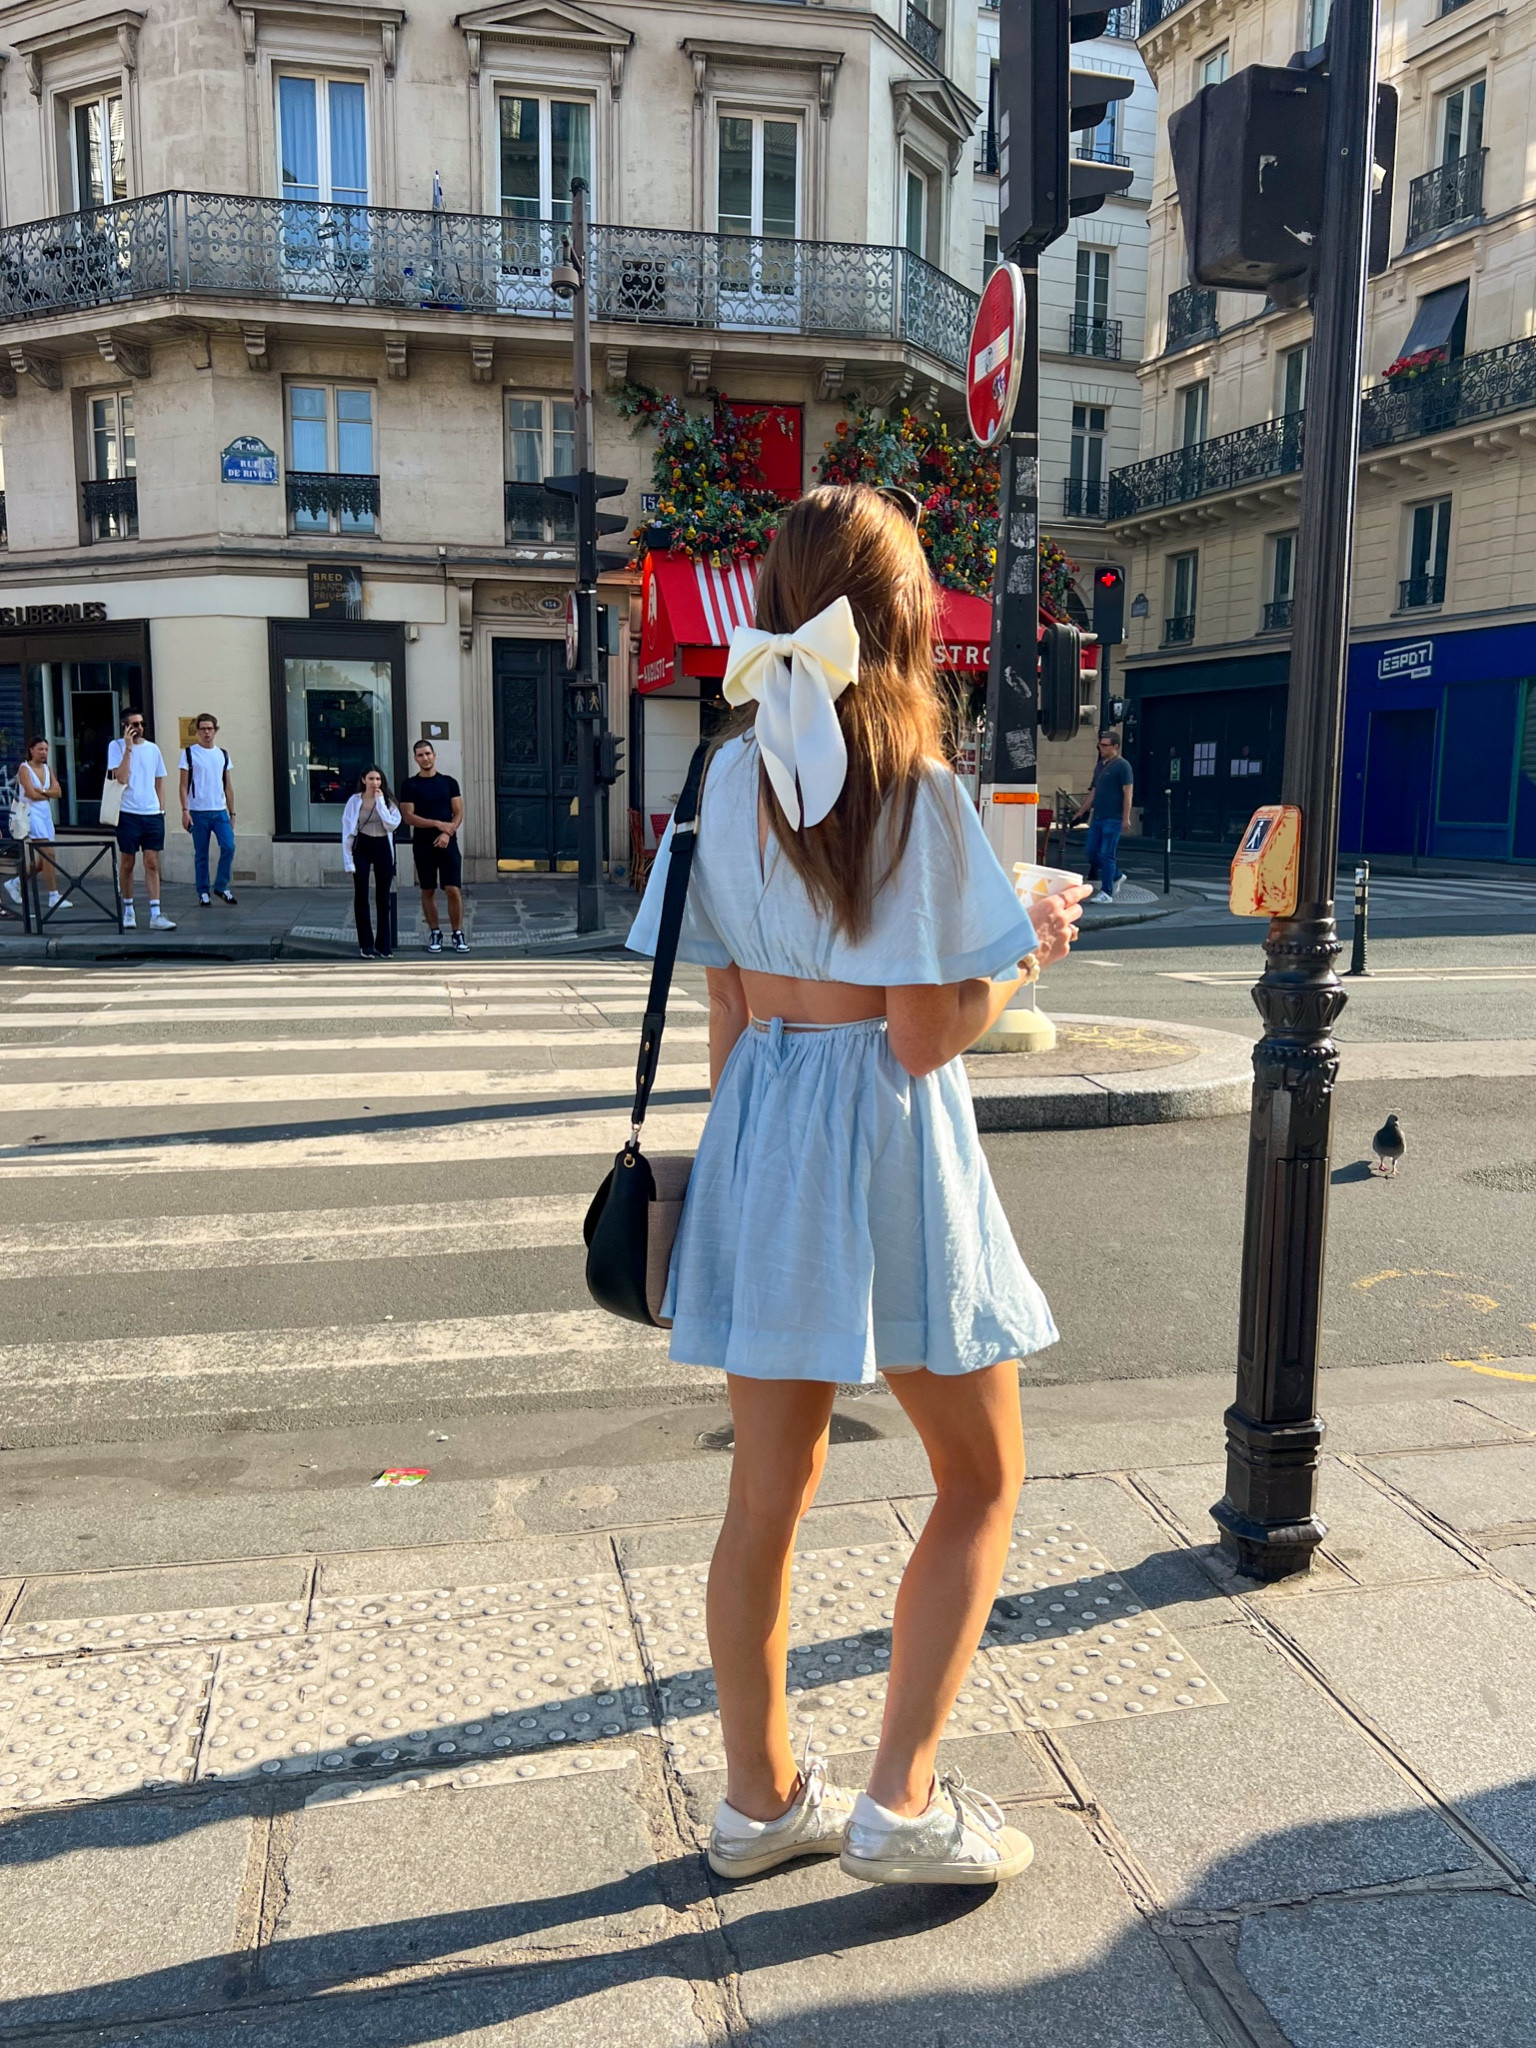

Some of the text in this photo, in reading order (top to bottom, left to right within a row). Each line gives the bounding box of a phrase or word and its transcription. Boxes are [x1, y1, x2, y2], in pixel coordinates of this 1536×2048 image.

[240, 460, 259, 468] RUE
[228, 469, 273, 479] DE RIVOLI
[642, 495, 660, 511] 15
[313, 573, 343, 582] BRED
